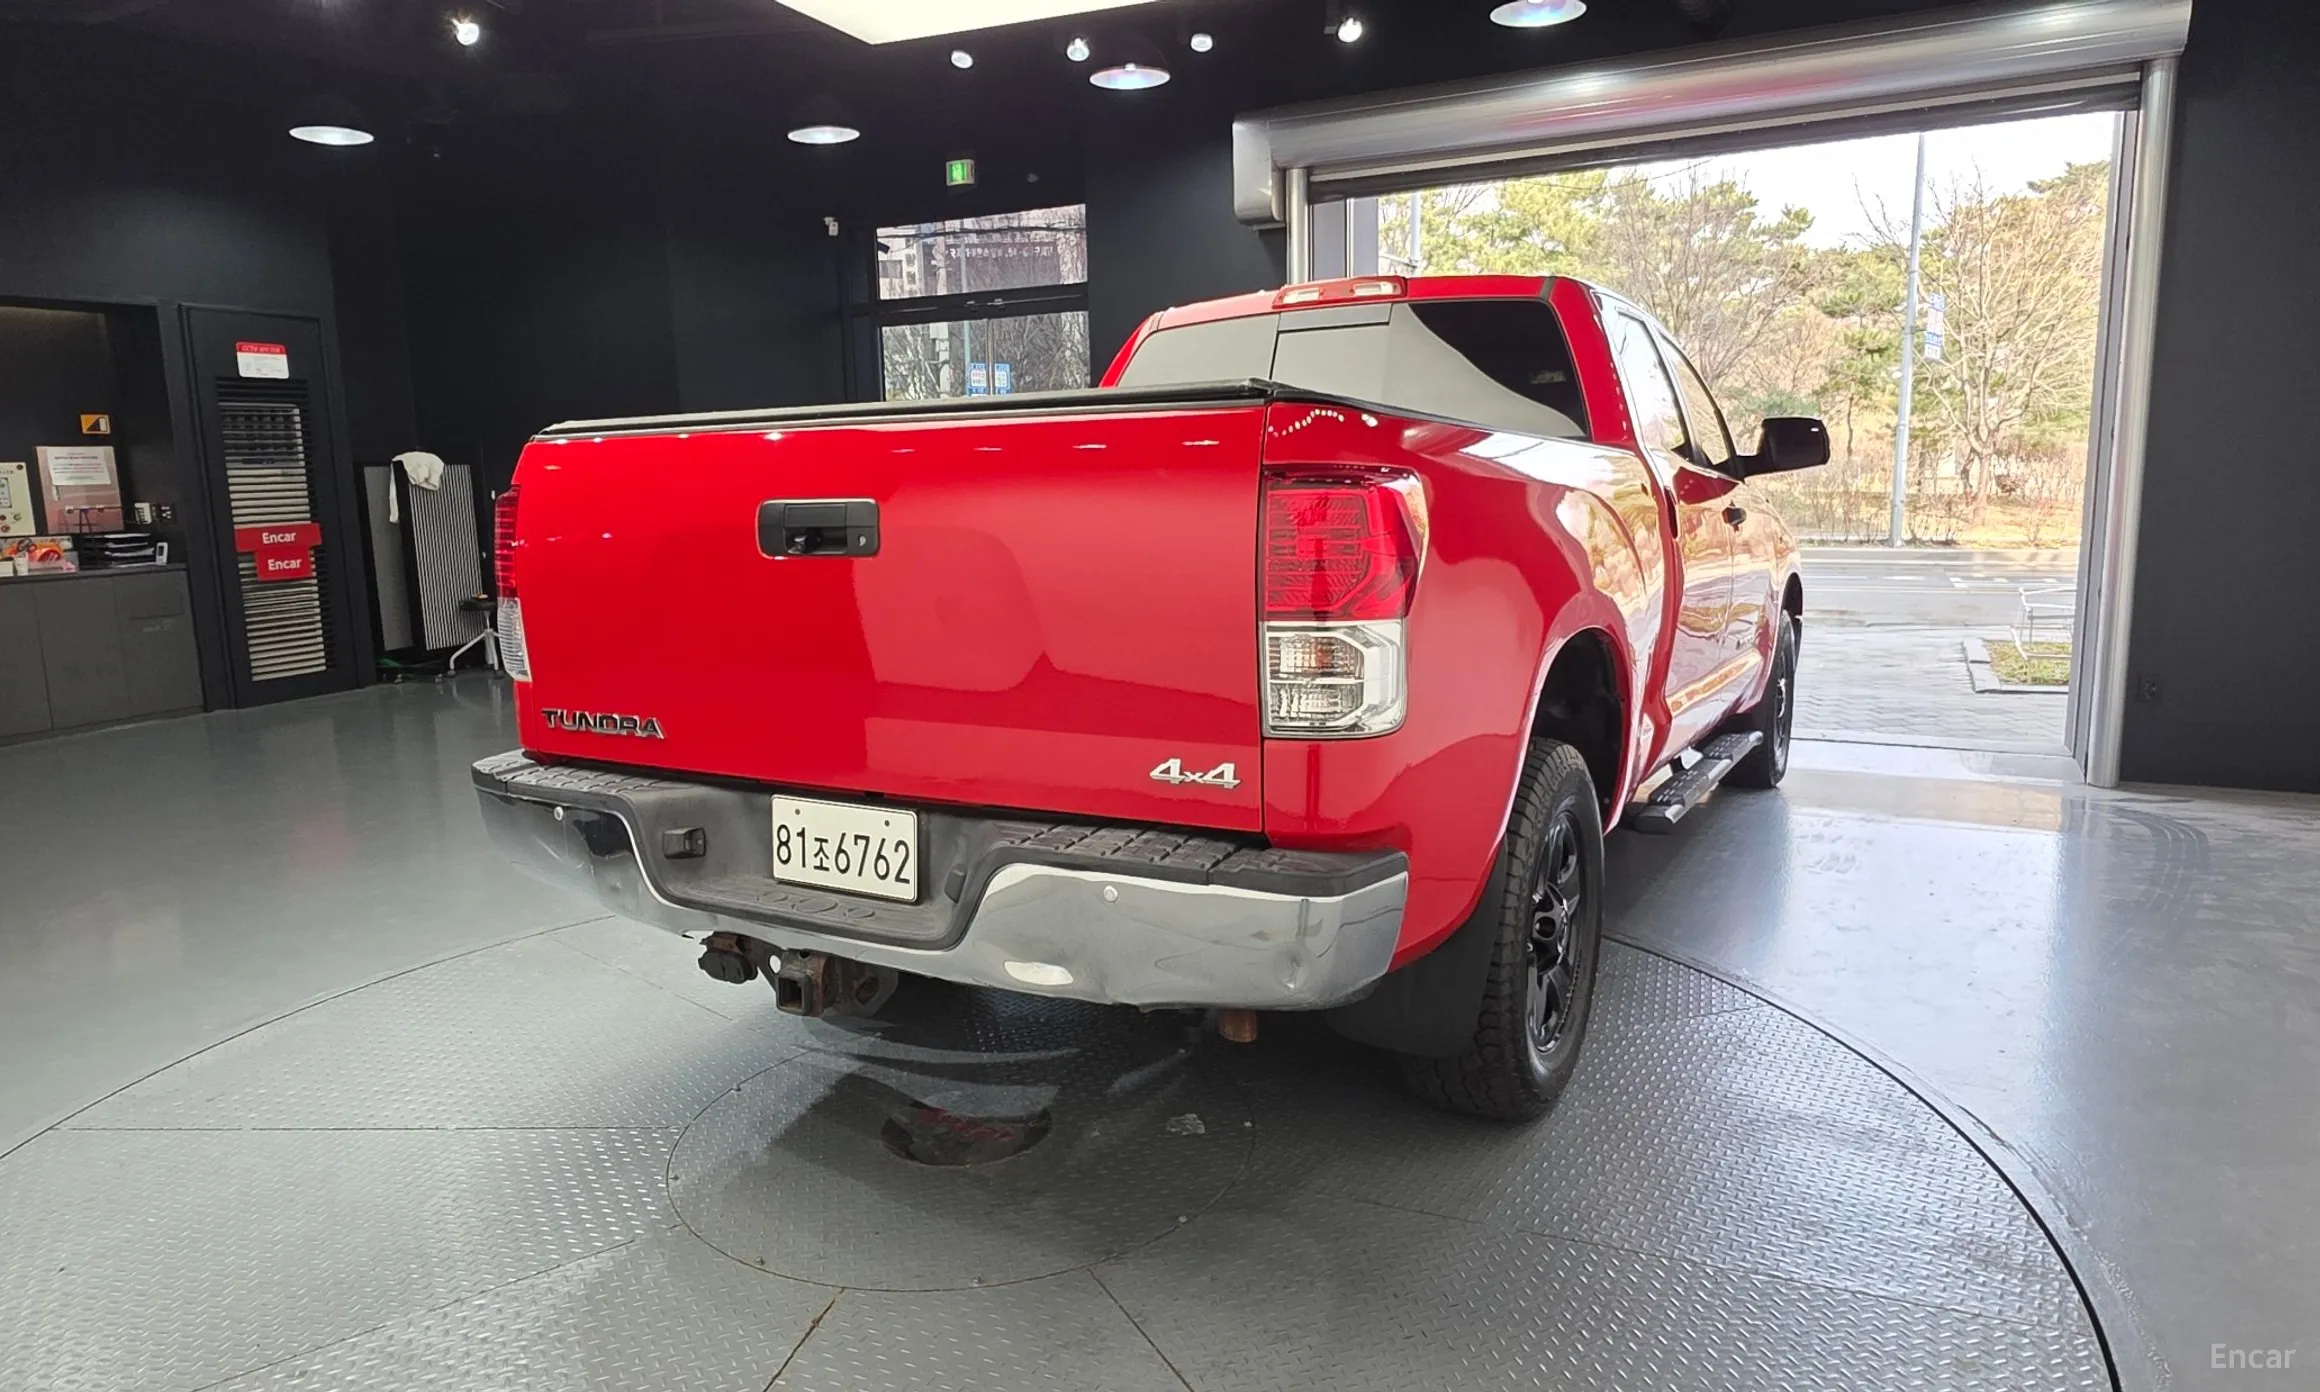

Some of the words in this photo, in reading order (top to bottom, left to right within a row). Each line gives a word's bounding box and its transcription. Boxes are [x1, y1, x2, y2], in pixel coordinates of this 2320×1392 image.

[262, 532, 297, 544] Encar
[267, 559, 302, 571] Encar
[541, 708, 666, 740] TUNDRA
[1150, 758, 1241, 789] 4x4
[776, 824, 911, 885] 81조6762
